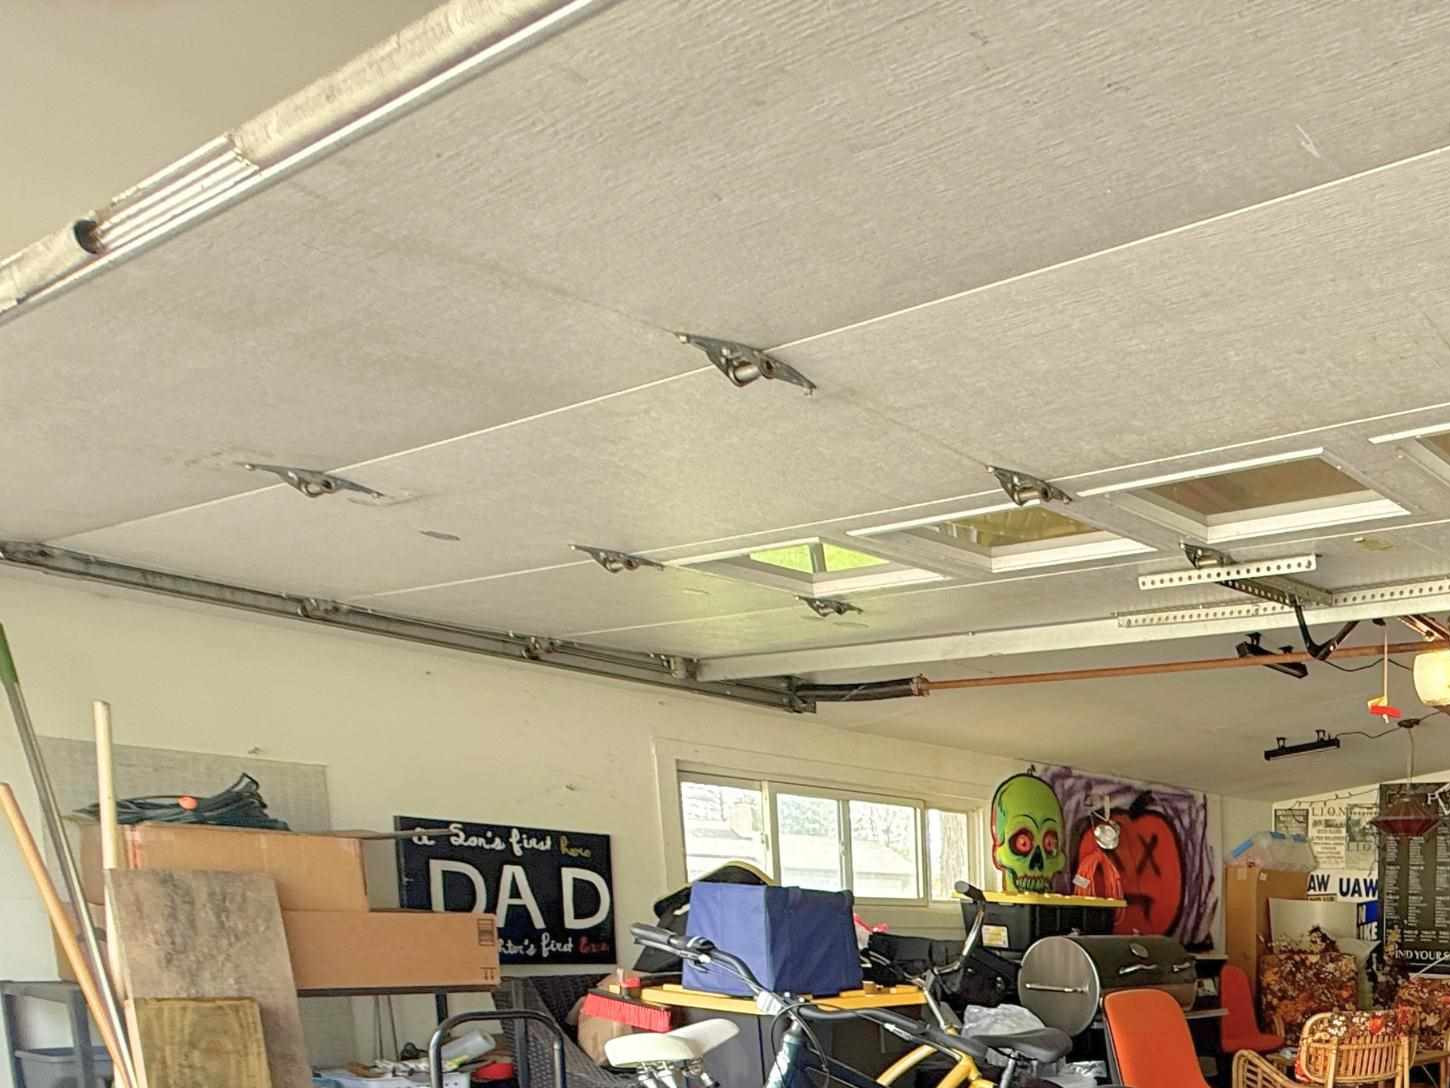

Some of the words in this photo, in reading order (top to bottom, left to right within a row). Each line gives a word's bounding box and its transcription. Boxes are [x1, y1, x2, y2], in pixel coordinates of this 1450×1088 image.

[450, 823, 506, 850] Son's
[510, 828, 552, 856] first
[428, 859, 611, 930] DAD
[1339, 877, 1378, 898] UAW
[541, 932, 574, 957] first
[1414, 949, 1441, 960] YOUR
